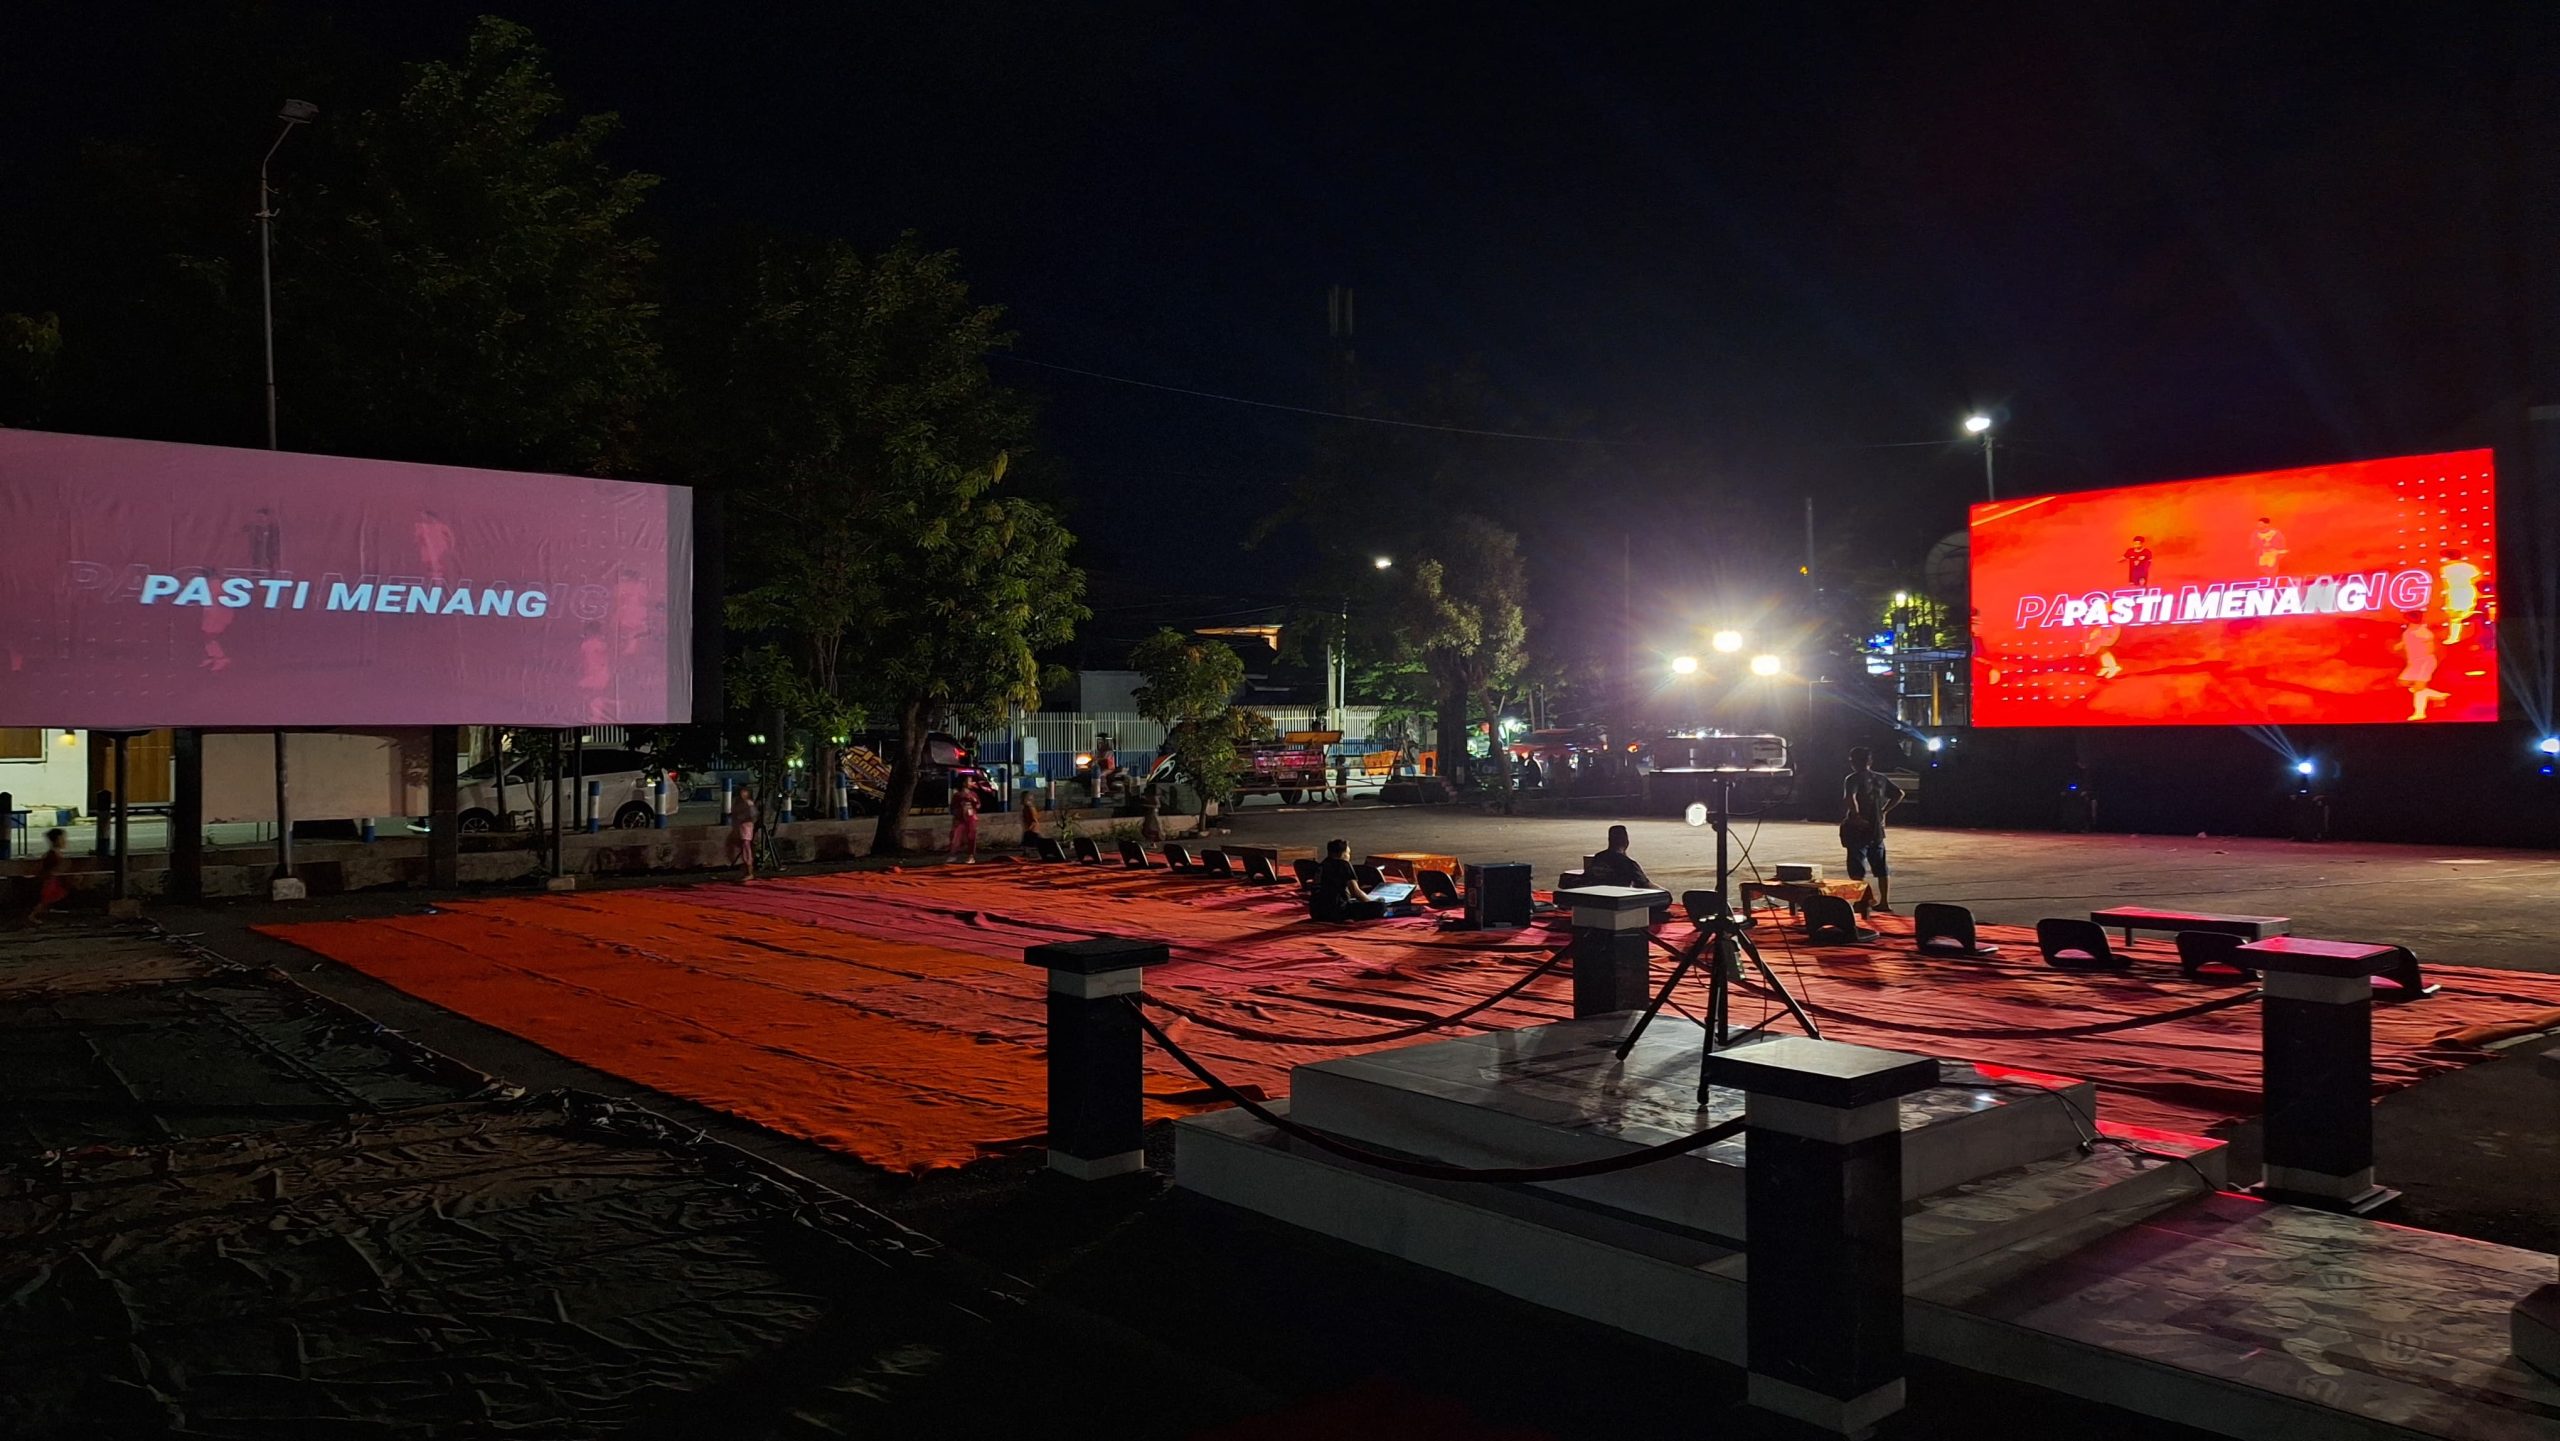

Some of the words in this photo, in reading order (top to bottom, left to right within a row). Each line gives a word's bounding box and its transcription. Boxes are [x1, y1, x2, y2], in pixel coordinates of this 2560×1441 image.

[140, 574, 310, 609] PASTI
[326, 582, 547, 618] MENANG
[2062, 594, 2173, 627] PASTI
[2183, 583, 2368, 620] MENANG
